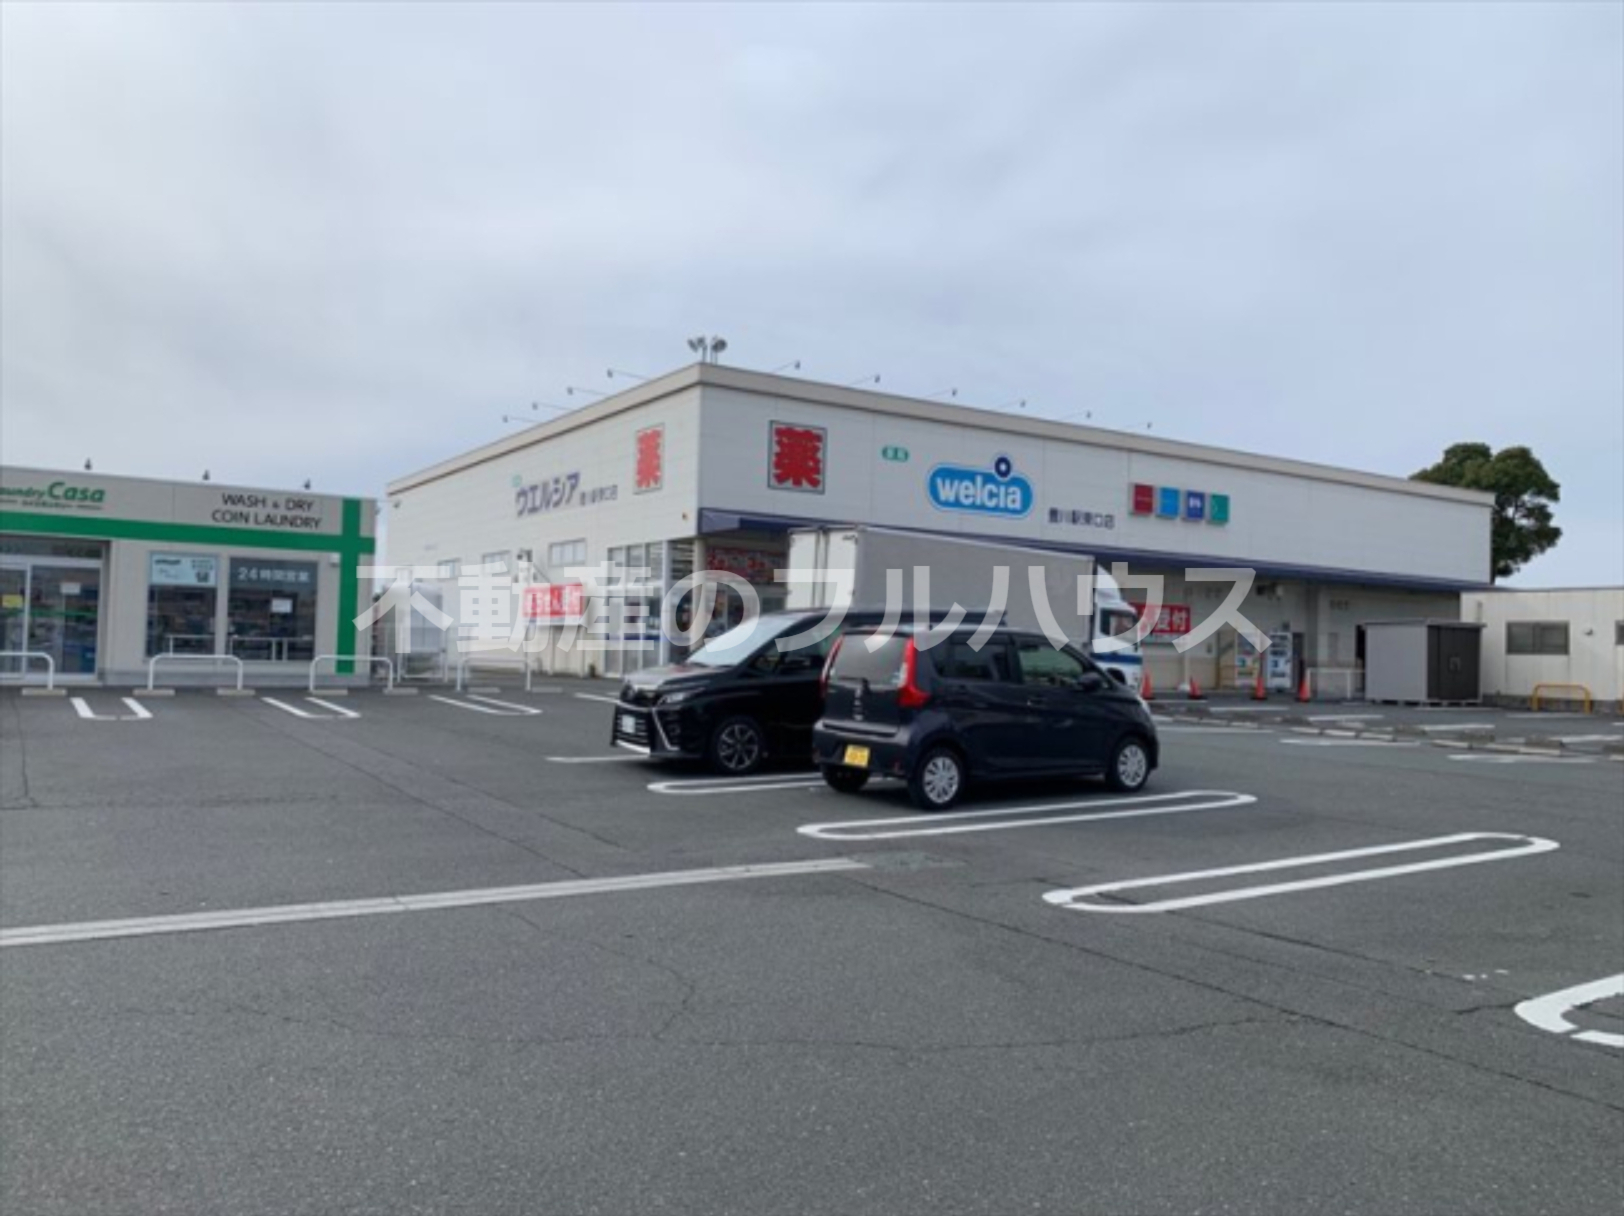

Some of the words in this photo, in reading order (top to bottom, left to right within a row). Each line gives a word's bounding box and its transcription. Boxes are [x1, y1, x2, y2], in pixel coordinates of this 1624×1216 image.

[773, 426, 823, 488] 薬
[48, 481, 105, 503] Casa
[515, 472, 580, 517] ウエルシア
[936, 457, 1022, 511] welcia
[222, 492, 267, 508] WASH
[285, 497, 315, 512] DRY
[211, 509, 250, 524] COIN
[254, 511, 322, 529] LAUNDRY
